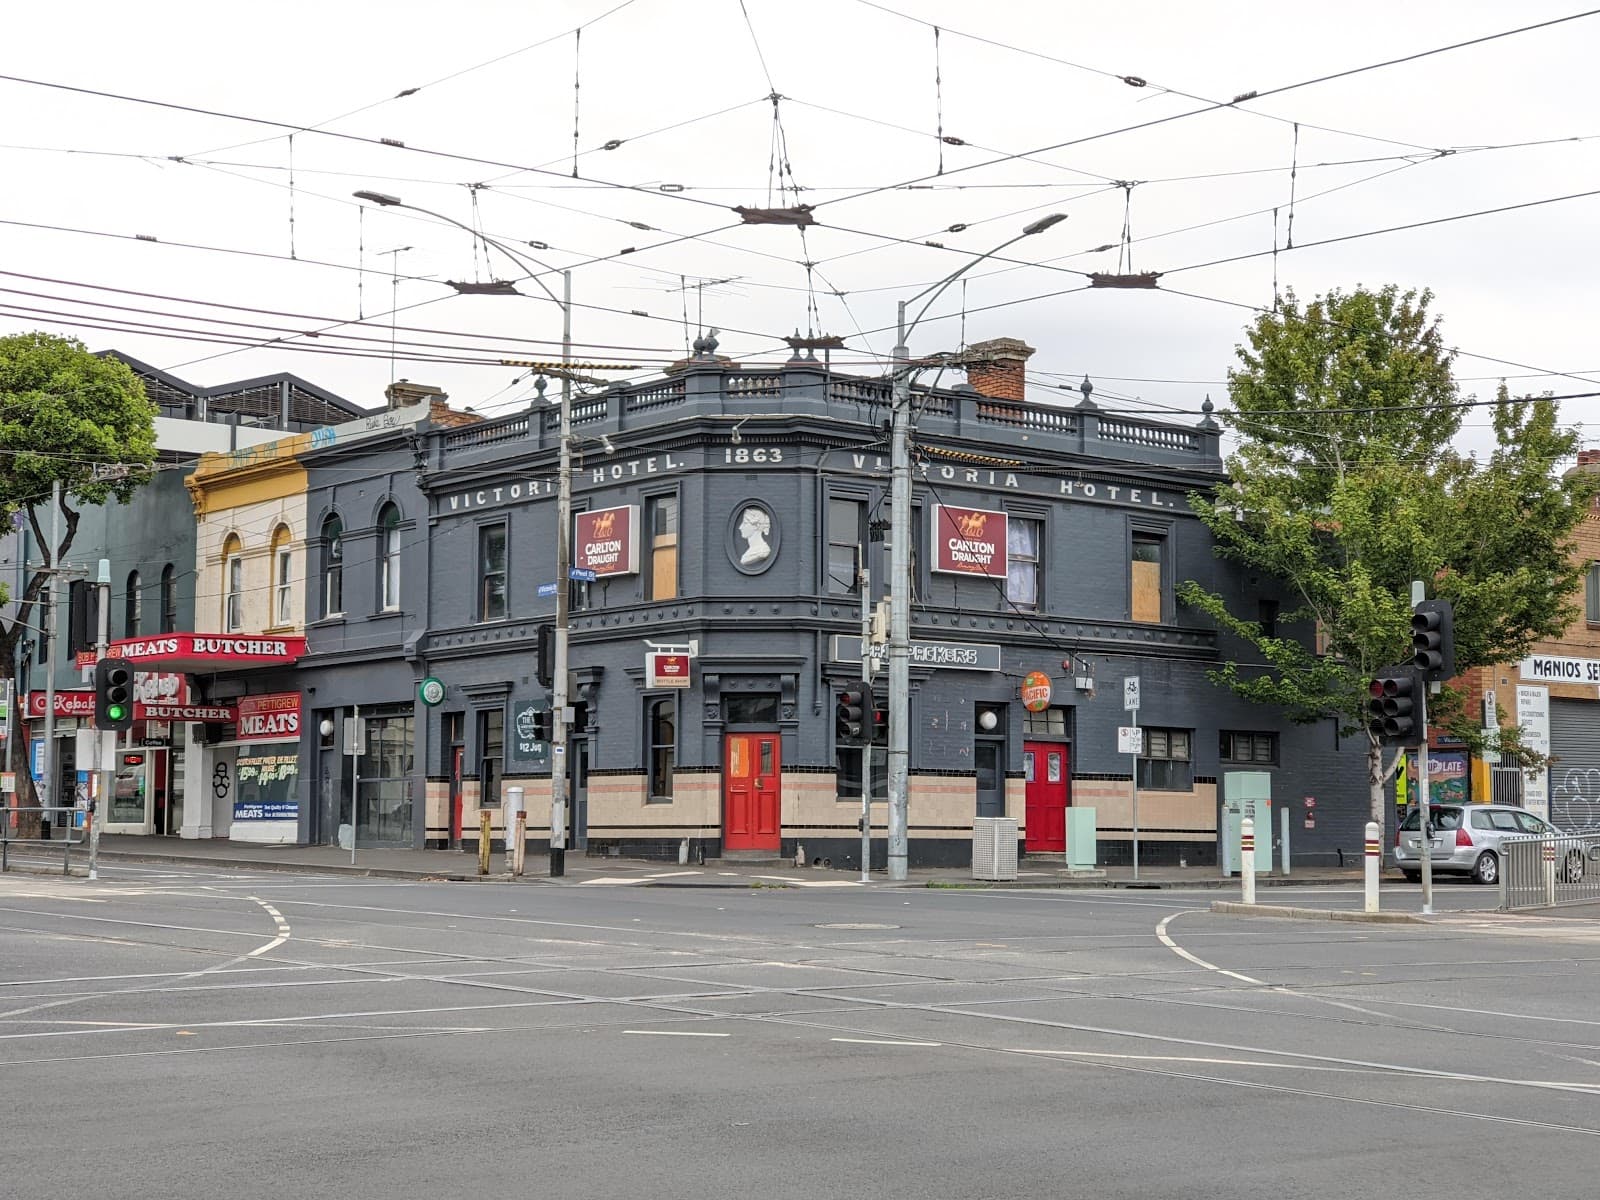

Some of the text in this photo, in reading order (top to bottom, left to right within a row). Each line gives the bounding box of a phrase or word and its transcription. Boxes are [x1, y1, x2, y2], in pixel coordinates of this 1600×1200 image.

[725, 448, 783, 464] 1863
[450, 453, 685, 511] VICTORI HOTEL.
[852, 454, 1174, 507] VITORIA HOTEL.
[585, 540, 621, 555] CARLTON
[948, 538, 995, 555] CARLTON
[587, 553, 619, 566] DRAUGHT
[952, 551, 992, 565] DRAUGHT
[121, 639, 178, 657] MEATS
[192, 638, 288, 655] BUTCHER
[1533, 658, 1600, 681] MANIOS SE
[257, 697, 299, 710] PETTIGREW
[146, 706, 231, 719] BUTCHER
[240, 712, 298, 735] MEATS
[1442, 761, 1462, 772] LATE
[234, 809, 263, 819] MEATS
